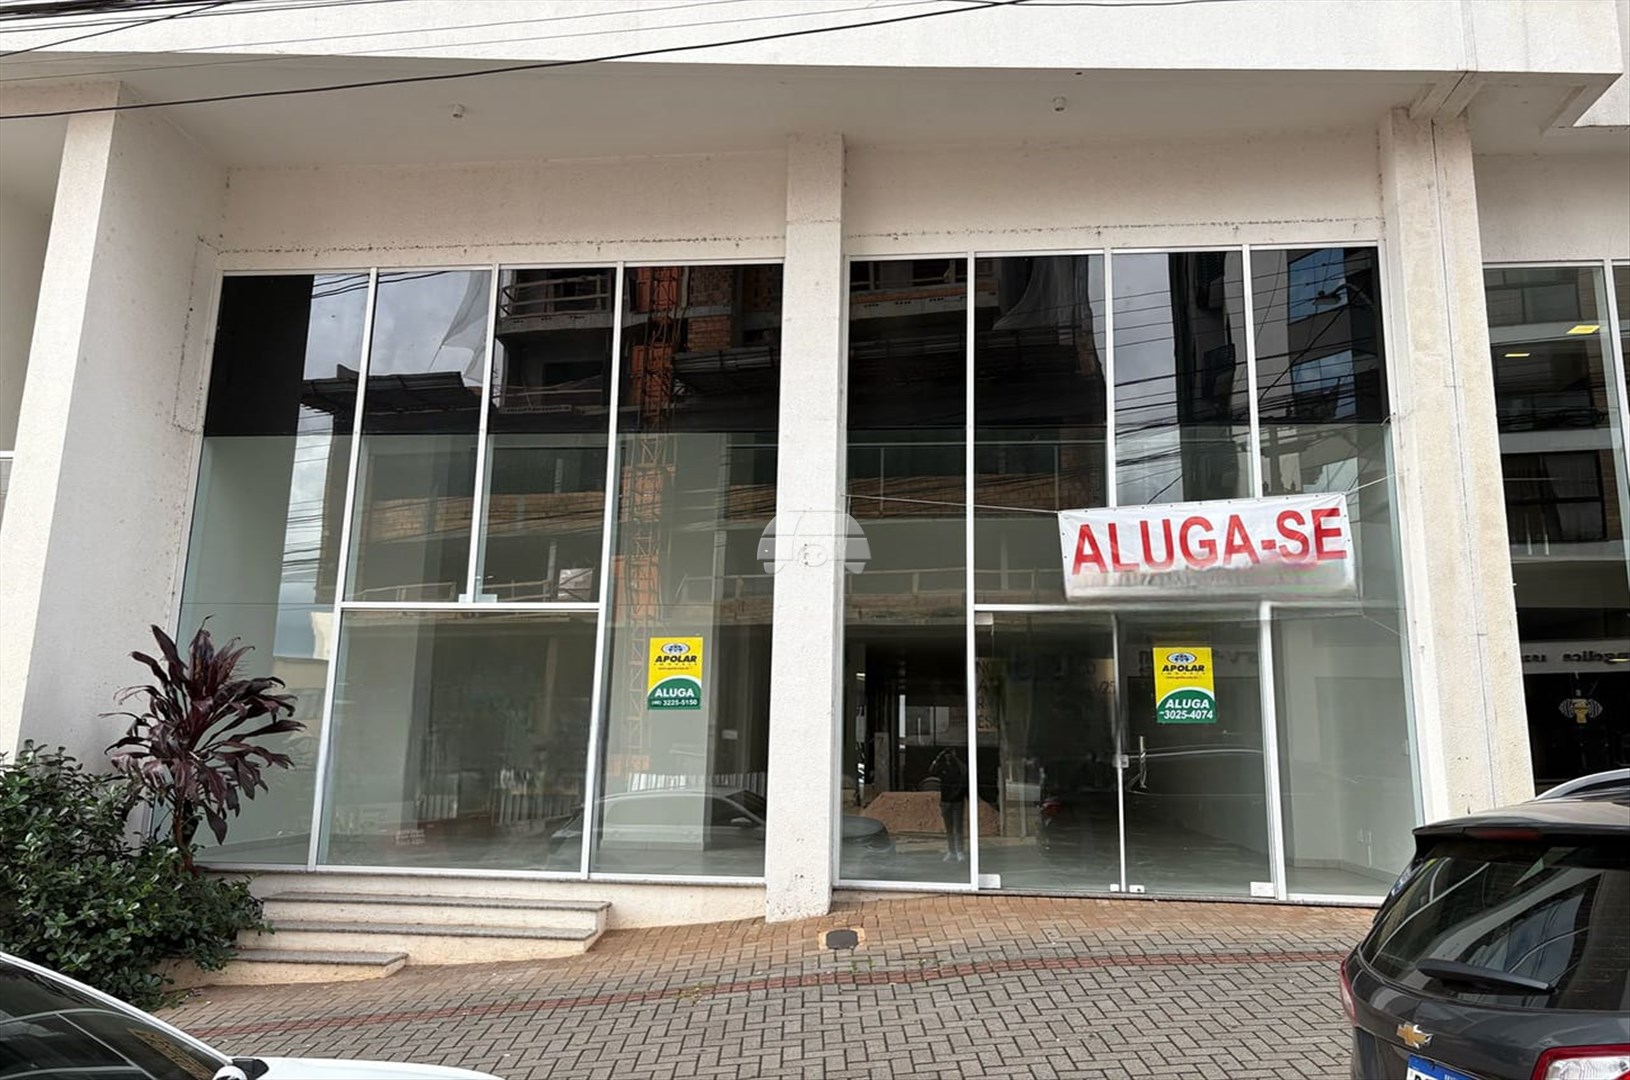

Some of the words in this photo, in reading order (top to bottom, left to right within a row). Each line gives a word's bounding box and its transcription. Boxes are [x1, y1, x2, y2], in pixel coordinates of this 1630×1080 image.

[1072, 507, 1348, 575] ALUGA-SE
[655, 655, 698, 663] APOLAR
[1162, 664, 1206, 672] APOLAR
[654, 687, 695, 697] ALUGA
[1165, 698, 1210, 709] ALUGA
[1163, 709, 1213, 719] 3025-4074
